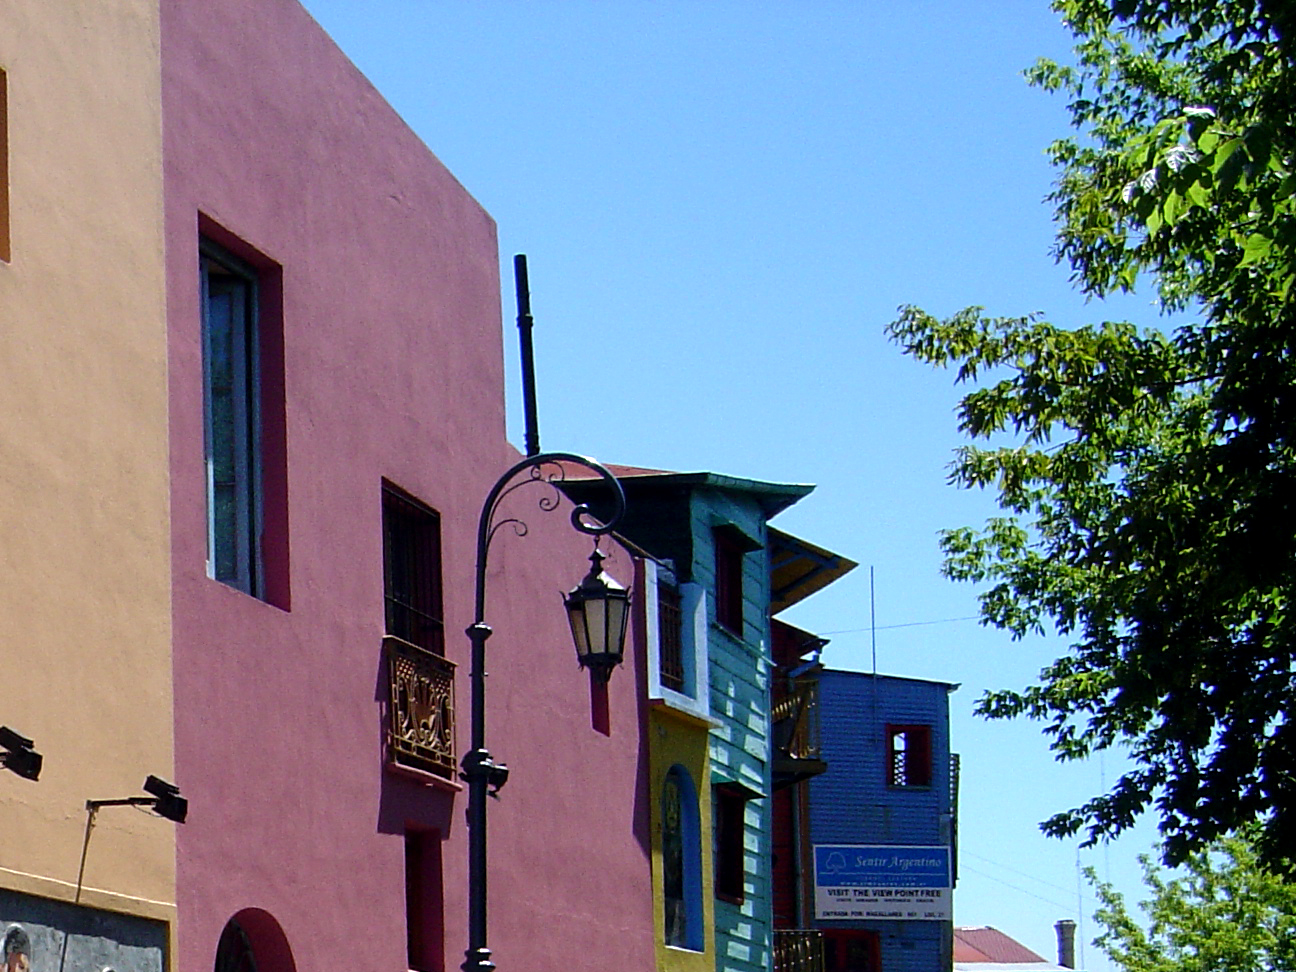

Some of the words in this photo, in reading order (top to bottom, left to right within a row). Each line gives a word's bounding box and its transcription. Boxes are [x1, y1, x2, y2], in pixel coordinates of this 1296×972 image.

[888, 856, 942, 871] Argentino
[827, 889, 849, 897] VISIT
[852, 889, 869, 897] THE
[872, 889, 892, 897] VIEW
[894, 890, 919, 898] POINT
[920, 890, 942, 898] FREE
